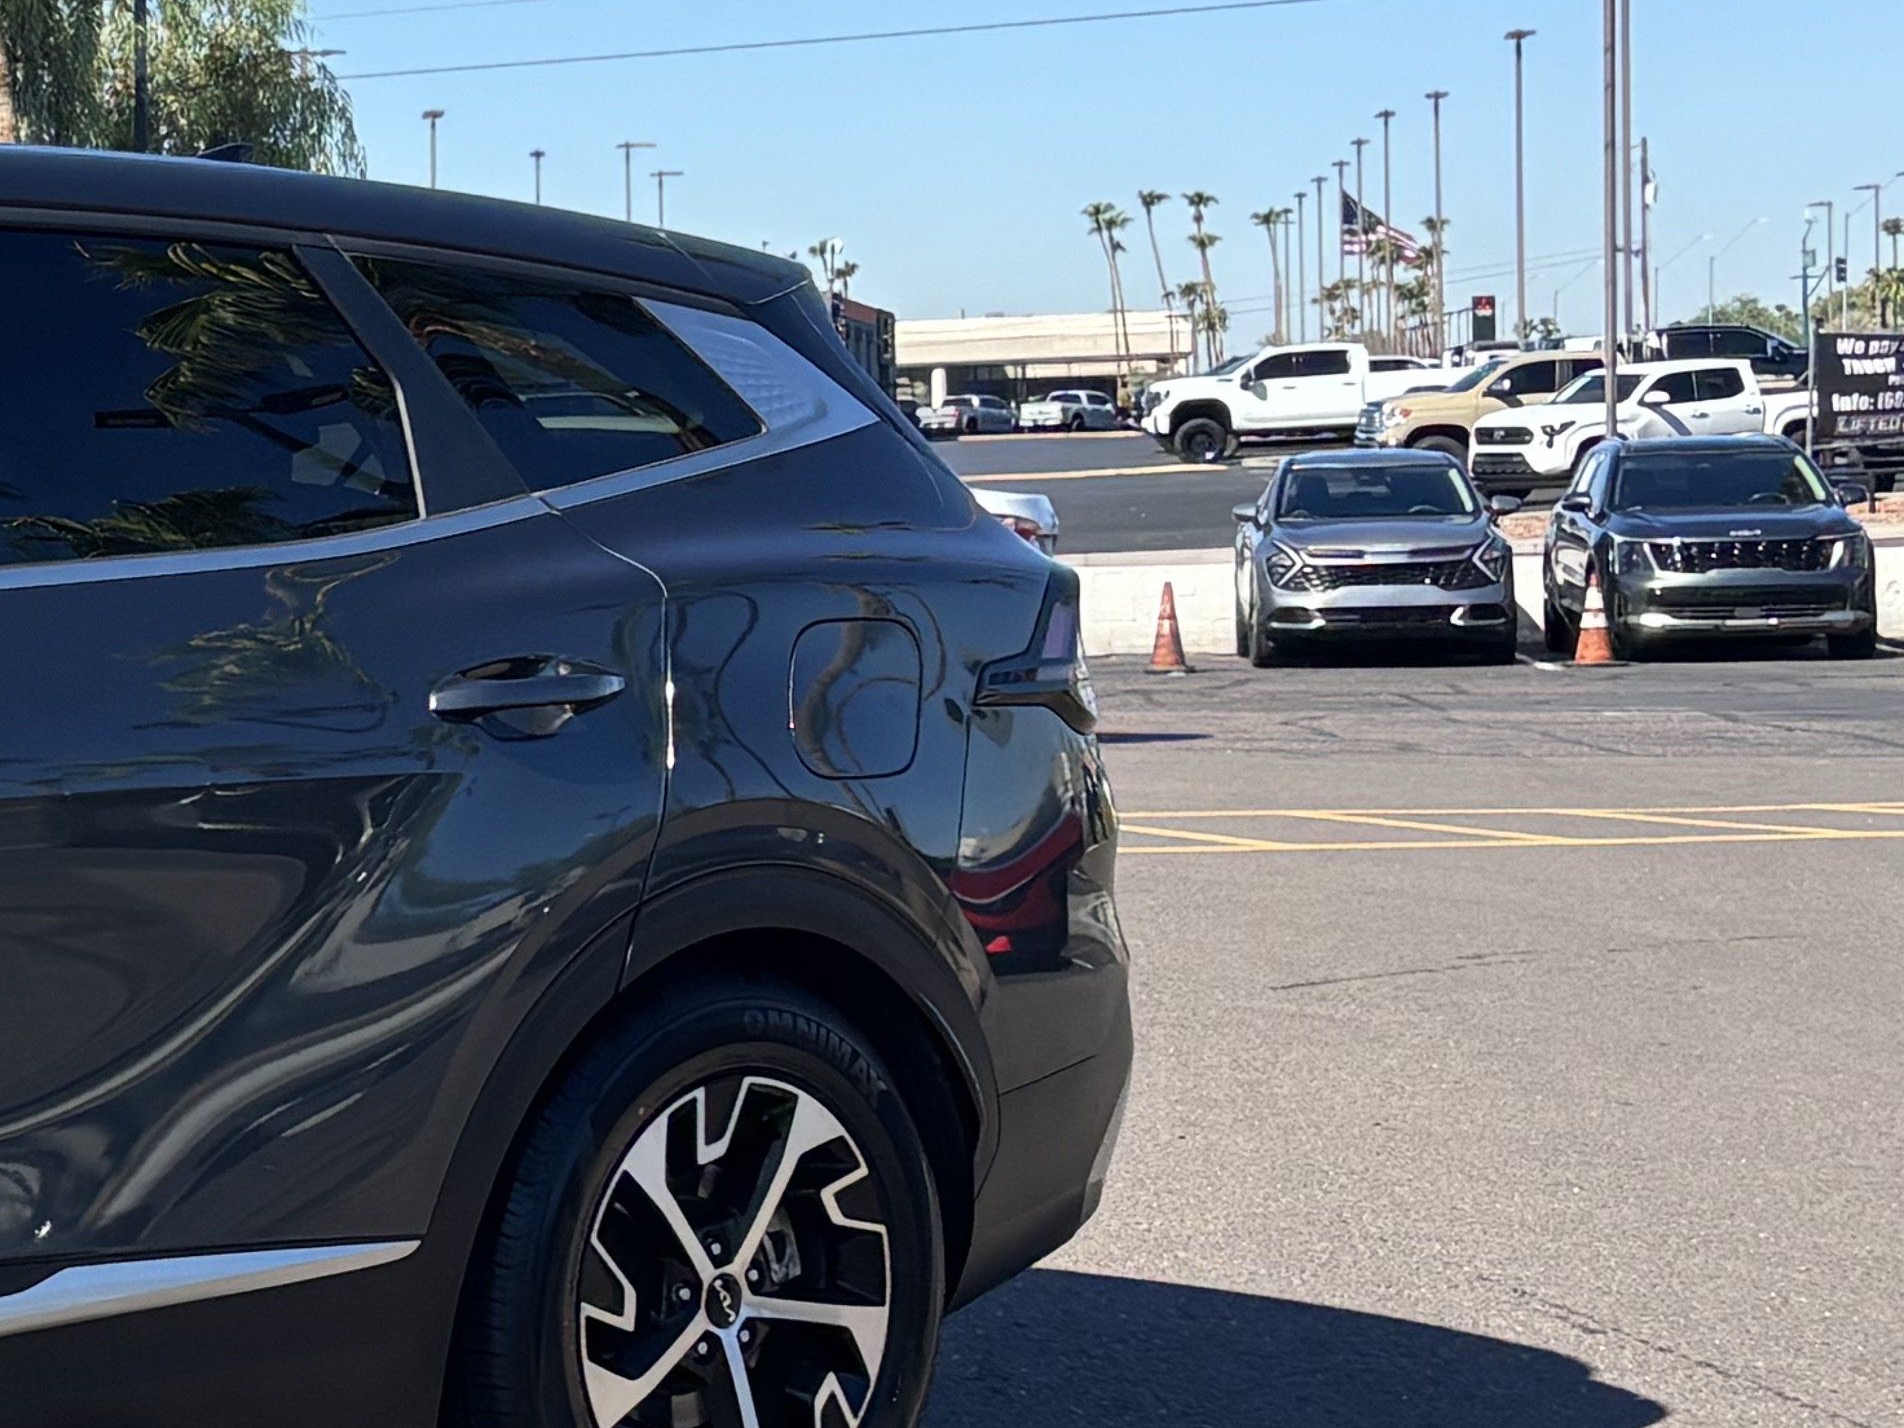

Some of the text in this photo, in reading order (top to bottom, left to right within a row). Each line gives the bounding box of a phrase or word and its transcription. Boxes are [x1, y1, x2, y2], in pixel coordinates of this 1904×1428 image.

[1836, 337, 1899, 356] We pay
[1832, 391, 1904, 412] Info: (60
